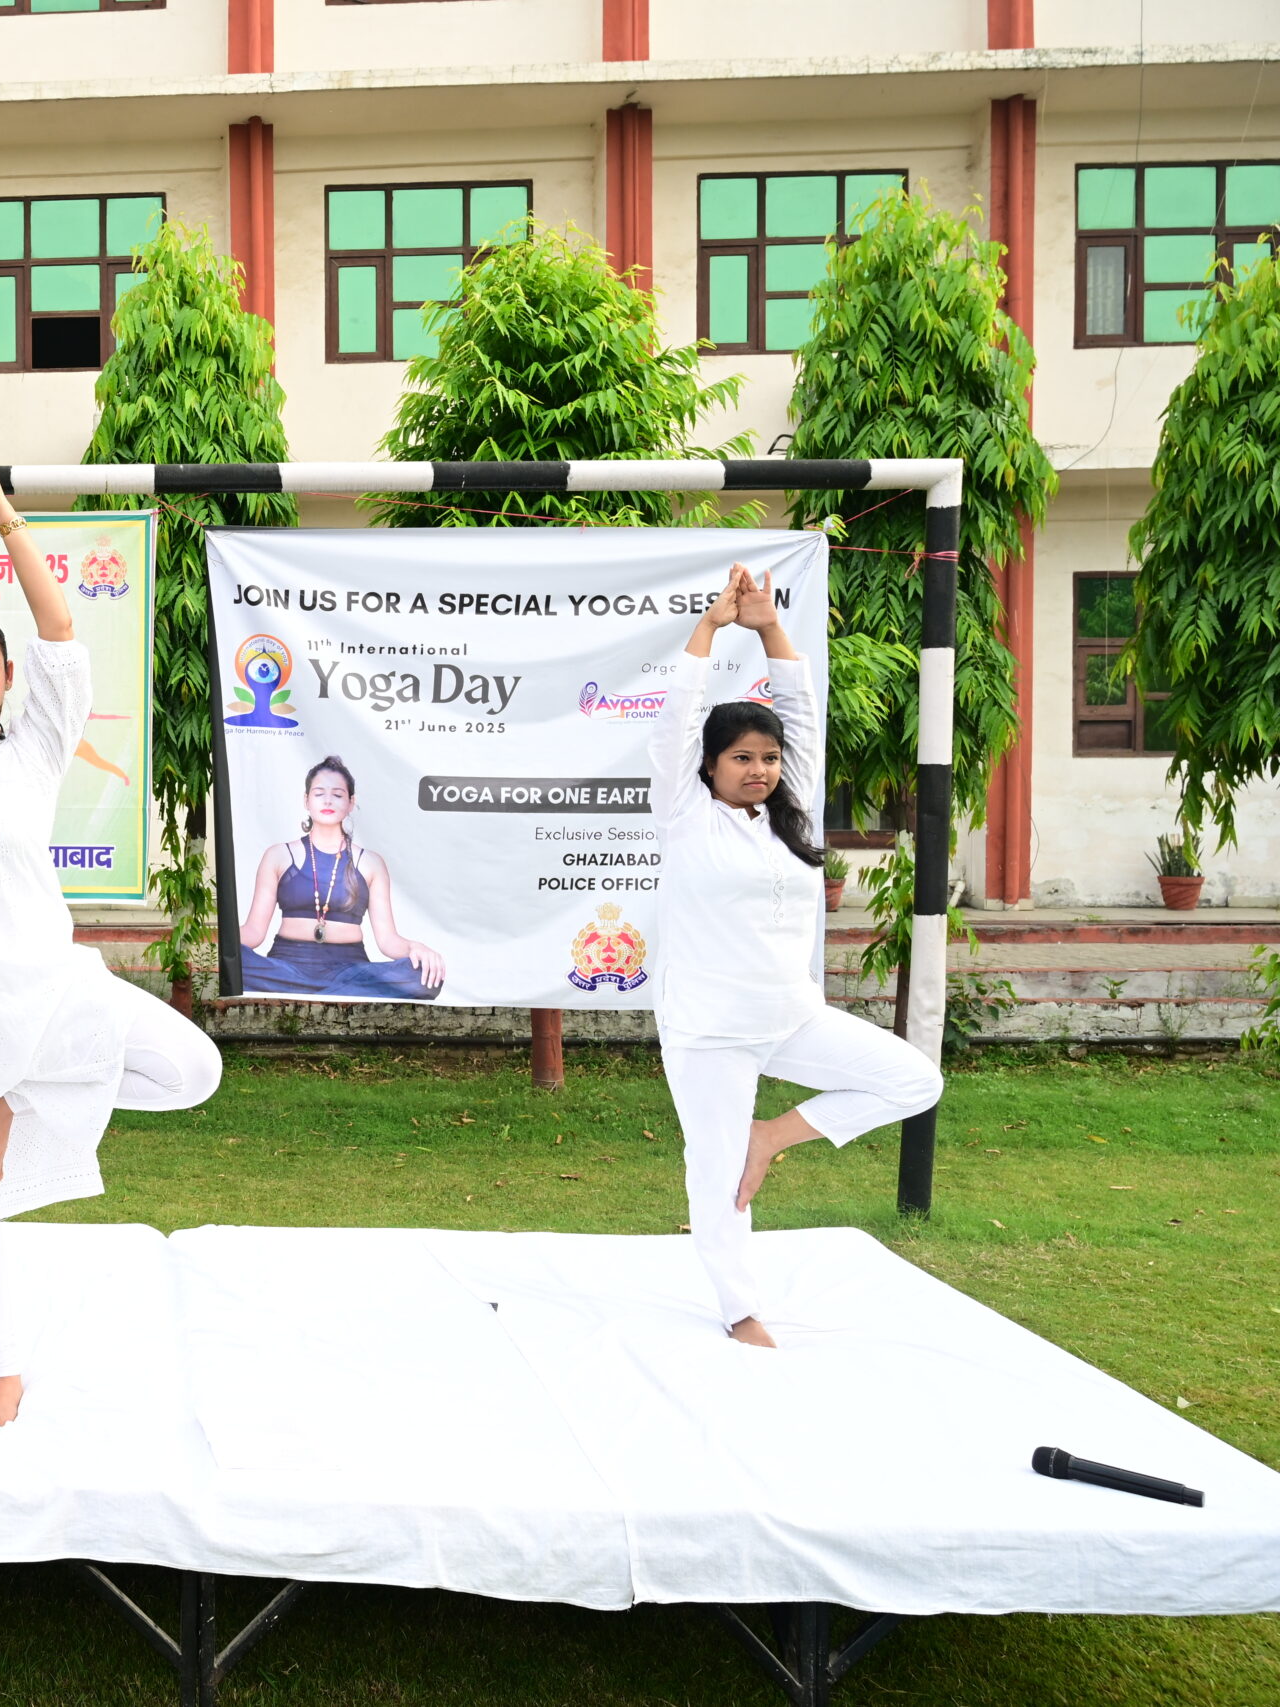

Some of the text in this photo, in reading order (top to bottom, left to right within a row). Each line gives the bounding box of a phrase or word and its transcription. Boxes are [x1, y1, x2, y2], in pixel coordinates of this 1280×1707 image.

[233, 584, 290, 610] JOIN
[299, 590, 337, 612] US
[346, 591, 401, 613] FOR
[409, 592, 429, 614] A
[438, 593, 558, 616] SPECIAL
[568, 594, 659, 616] YOGA
[307, 638, 468, 656] 11th International
[727, 659, 741, 674] by
[308, 658, 522, 715] Yoga Day
[594, 695, 666, 718] Avprav
[625, 711, 660, 719] FOUND
[385, 719, 506, 734] 21st June 2025
[428, 785, 652, 805] YOGA FOR ONE EART
[535, 826, 658, 841] Exclusive Sessio
[562, 853, 661, 867] GHAZIABAD
[538, 877, 659, 891] POLICE OFFIC
